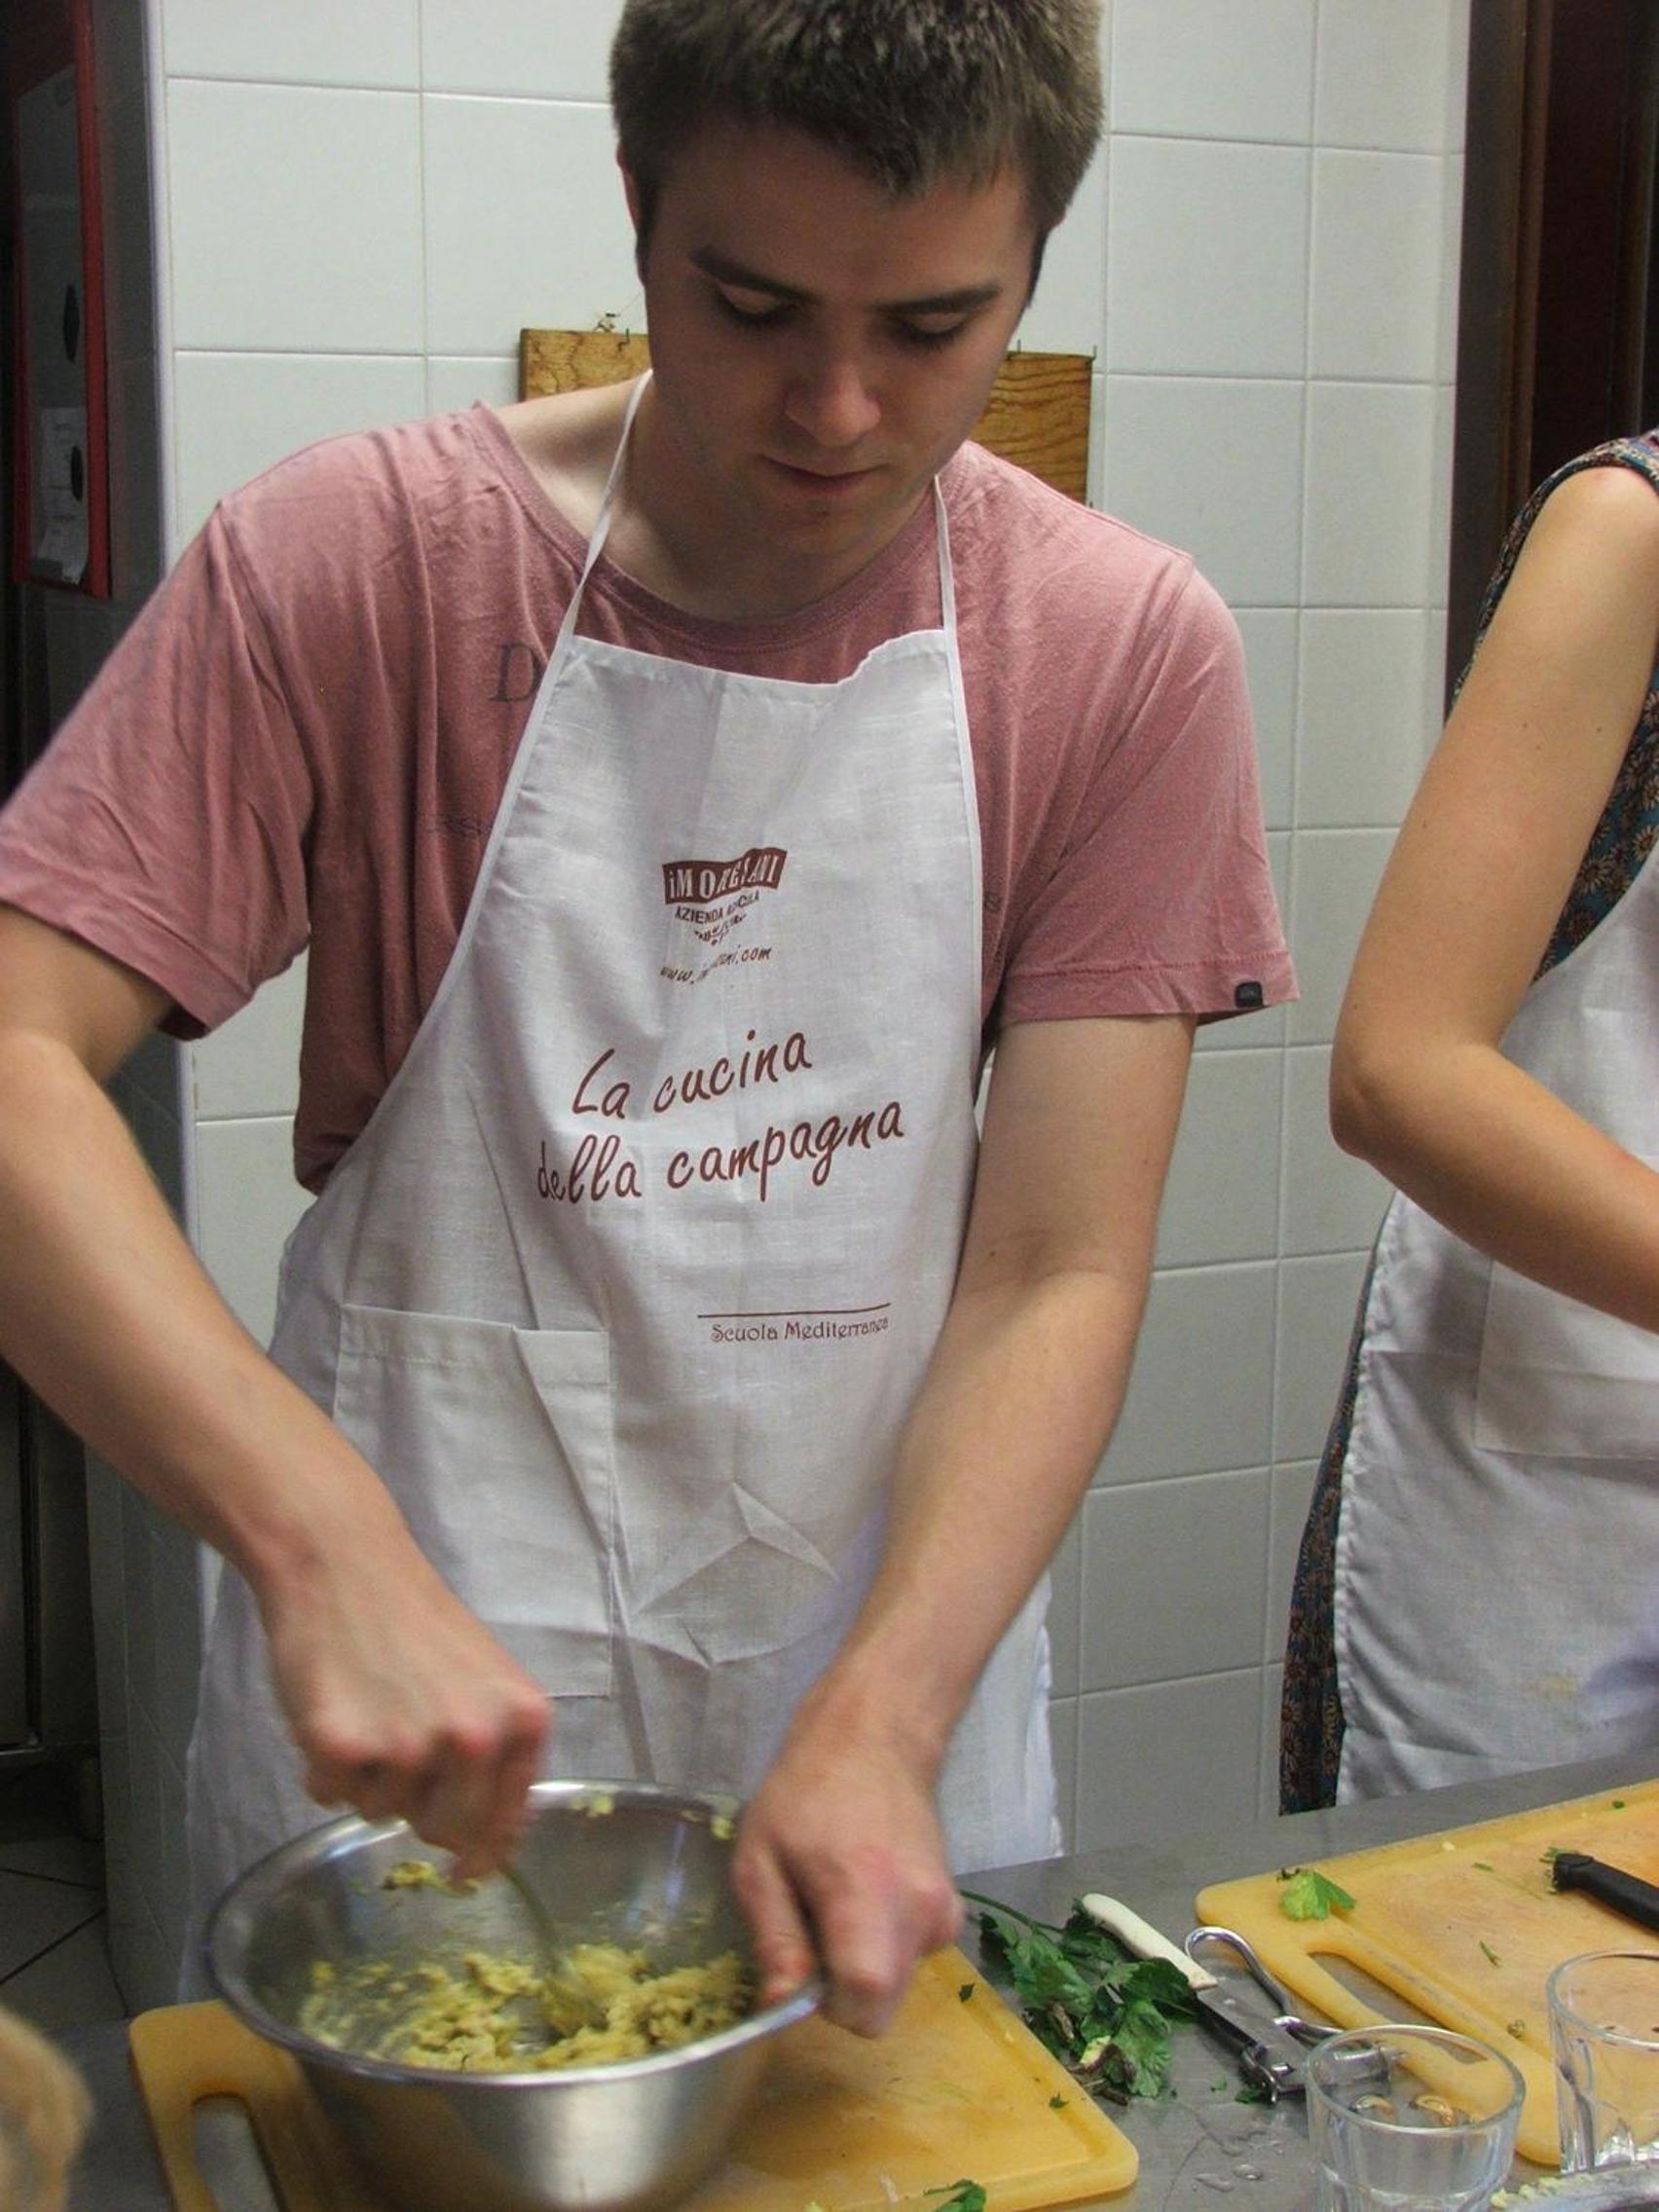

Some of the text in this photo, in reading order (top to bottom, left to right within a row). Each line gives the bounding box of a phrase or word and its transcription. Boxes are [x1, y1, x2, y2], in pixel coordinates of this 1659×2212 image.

[489, 639, 542, 702] D
[675, 905, 723, 924] AZIENDA
[571, 1029, 813, 1120] La cucina
[537, 1101, 904, 1204] della campagna
[711, 1323, 778, 1343] Scuola
